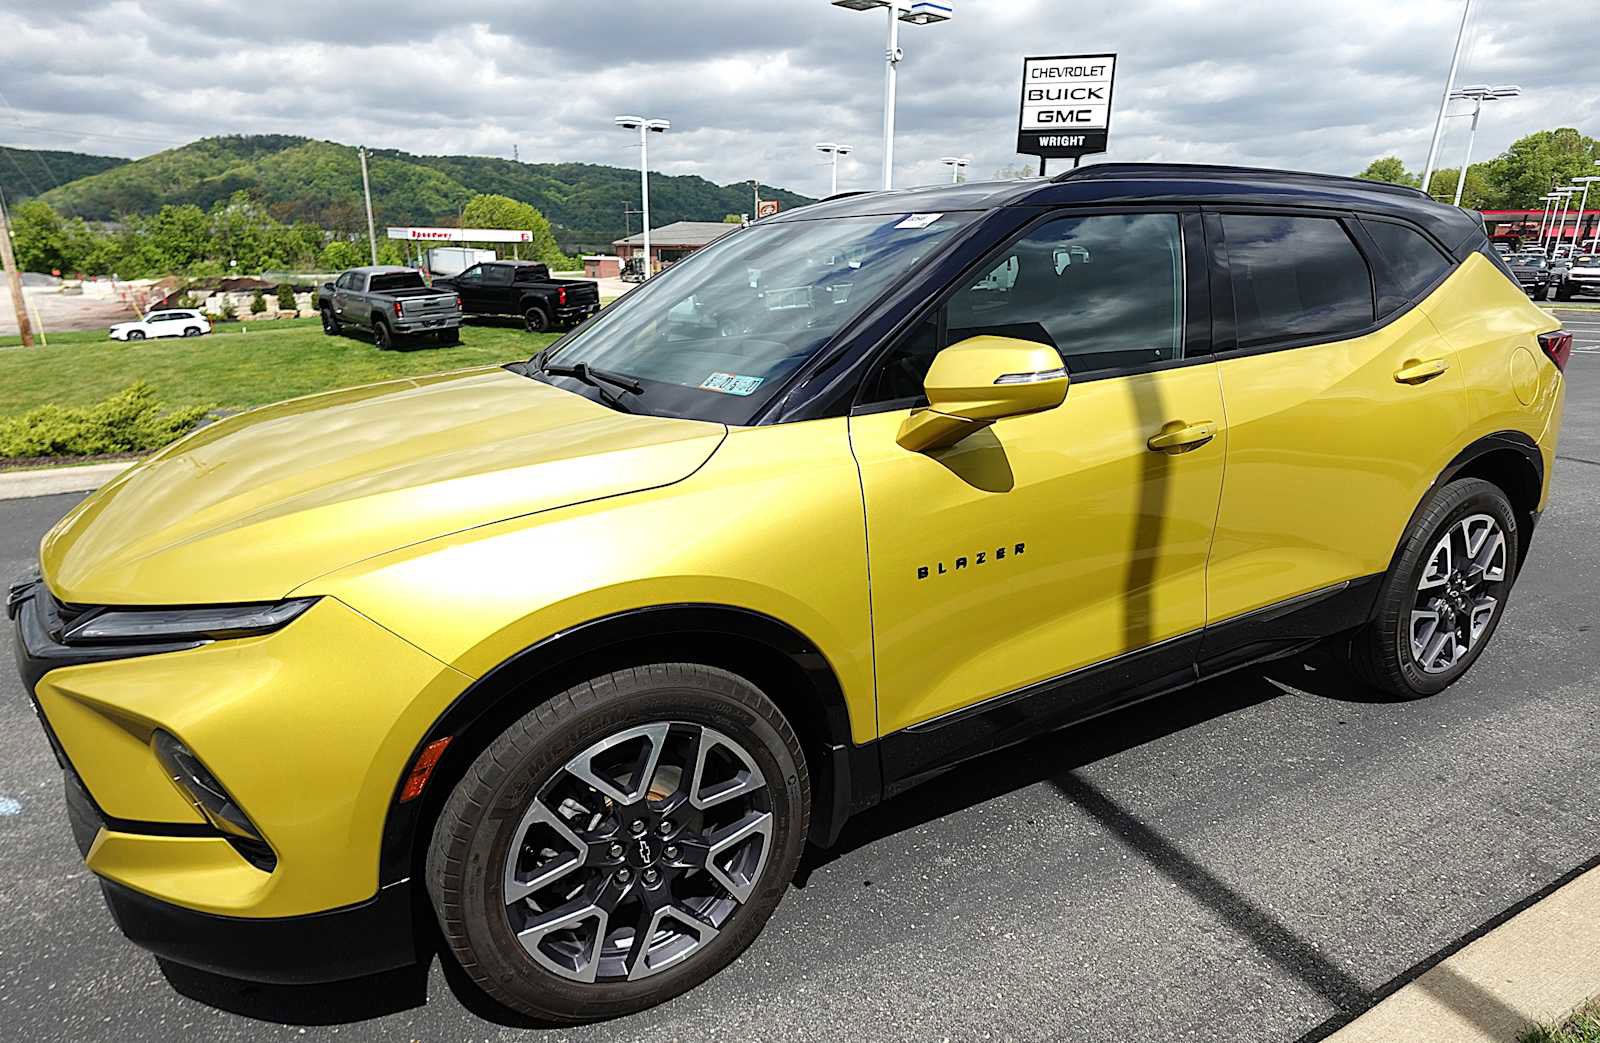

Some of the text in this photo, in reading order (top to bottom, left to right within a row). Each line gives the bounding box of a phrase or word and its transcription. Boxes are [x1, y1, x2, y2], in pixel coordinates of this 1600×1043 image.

[1031, 65, 1107, 79] CHEVROLET
[1028, 87, 1104, 101] BUICK
[1037, 109, 1092, 123] GMC
[1039, 136, 1085, 147] WRIGHT
[917, 542, 1025, 580] BLAZER
